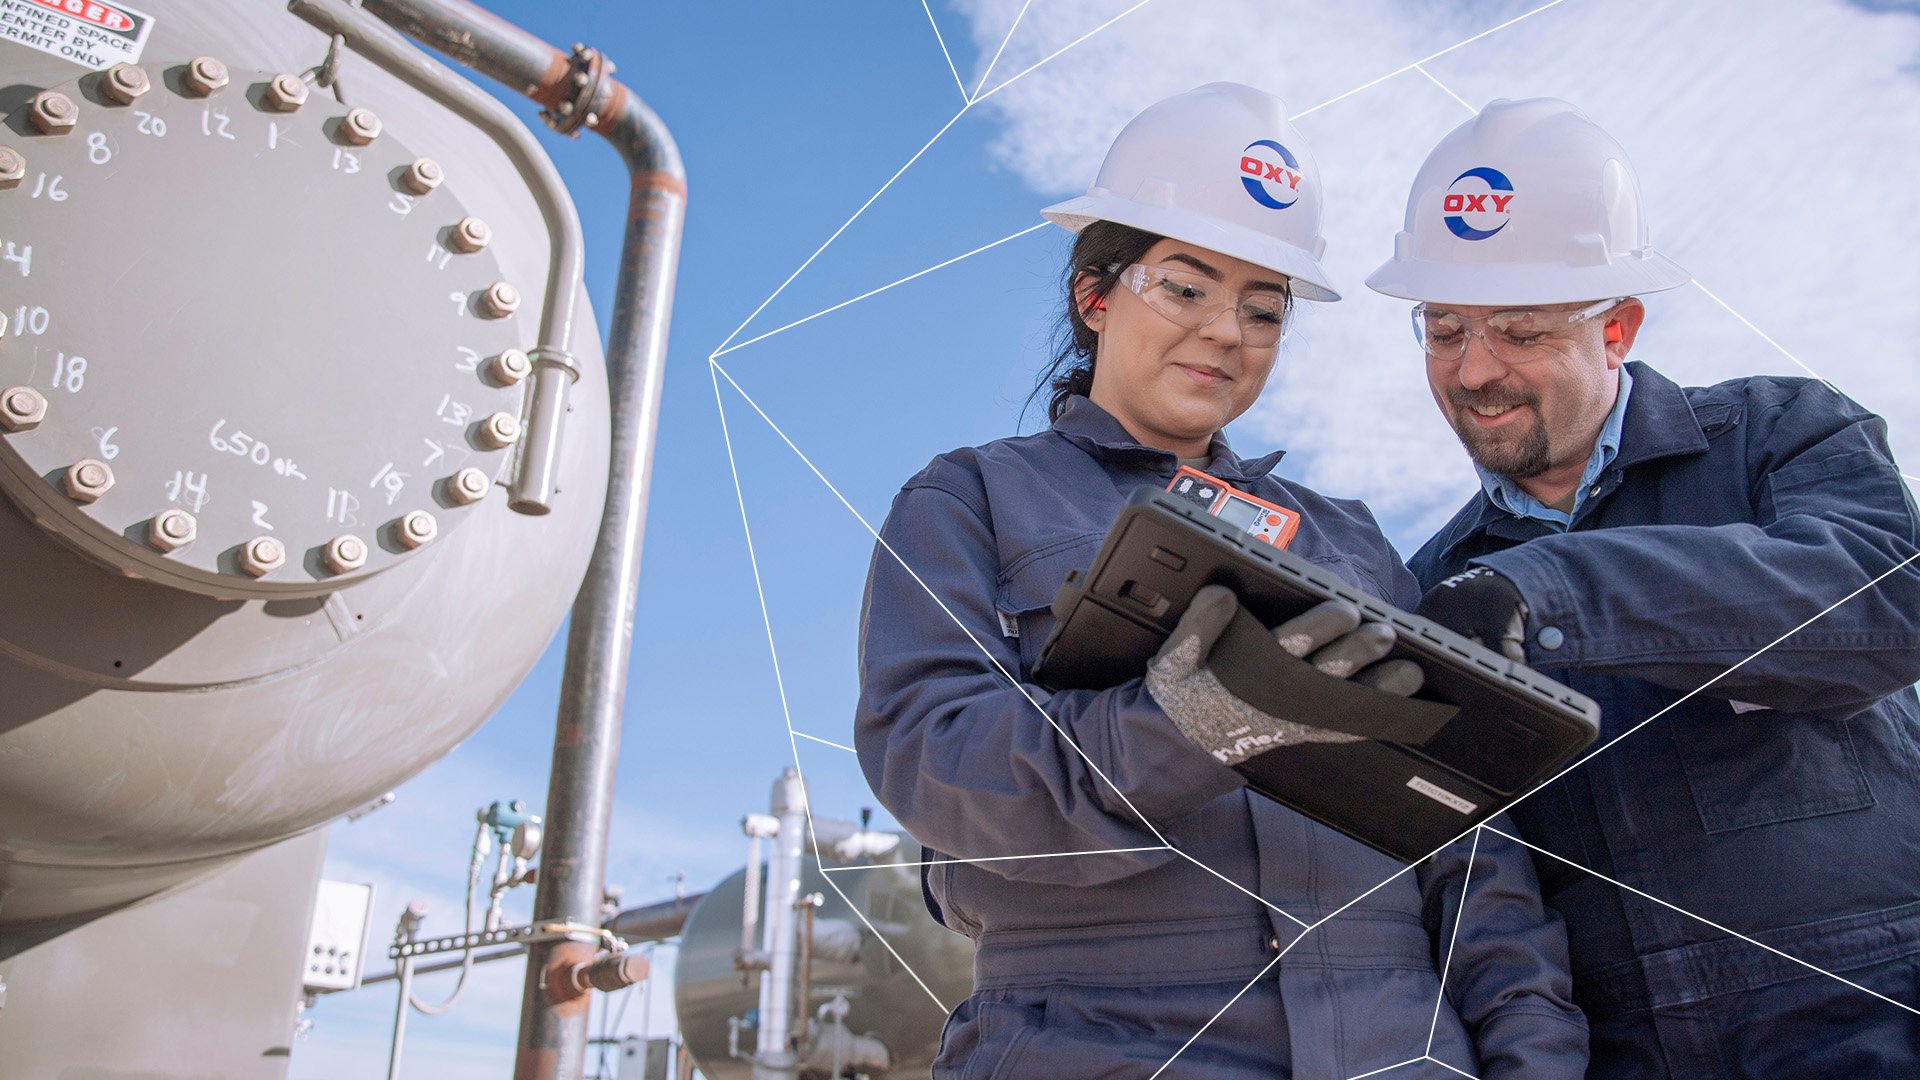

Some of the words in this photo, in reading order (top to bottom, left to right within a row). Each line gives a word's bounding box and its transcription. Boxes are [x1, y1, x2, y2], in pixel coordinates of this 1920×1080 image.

[2, 12, 66, 40] ENTER
[72, 36, 97, 51] BY
[78, 26, 135, 53] SPACE
[60, 45, 105, 66] ONLY
[134, 110, 167, 137] 20
[201, 106, 236, 140] 12
[268, 121, 278, 149] 1
[87, 132, 112, 164] 8
[332, 148, 361, 174] 13
[31, 172, 69, 201] 16
[1240, 156, 1302, 191] OXY
[1443, 194, 1514, 213] OXY
[450, 291, 468, 317] 9
[14, 305, 50, 336] 10
[52, 353, 88, 393] 18
[455, 346, 480, 373] 3
[99, 426, 120, 460] 6
[209, 419, 271, 466] 650
[423, 437, 446, 467] 7
[167, 470, 209, 514] 14
[251, 500, 275, 531] 2
